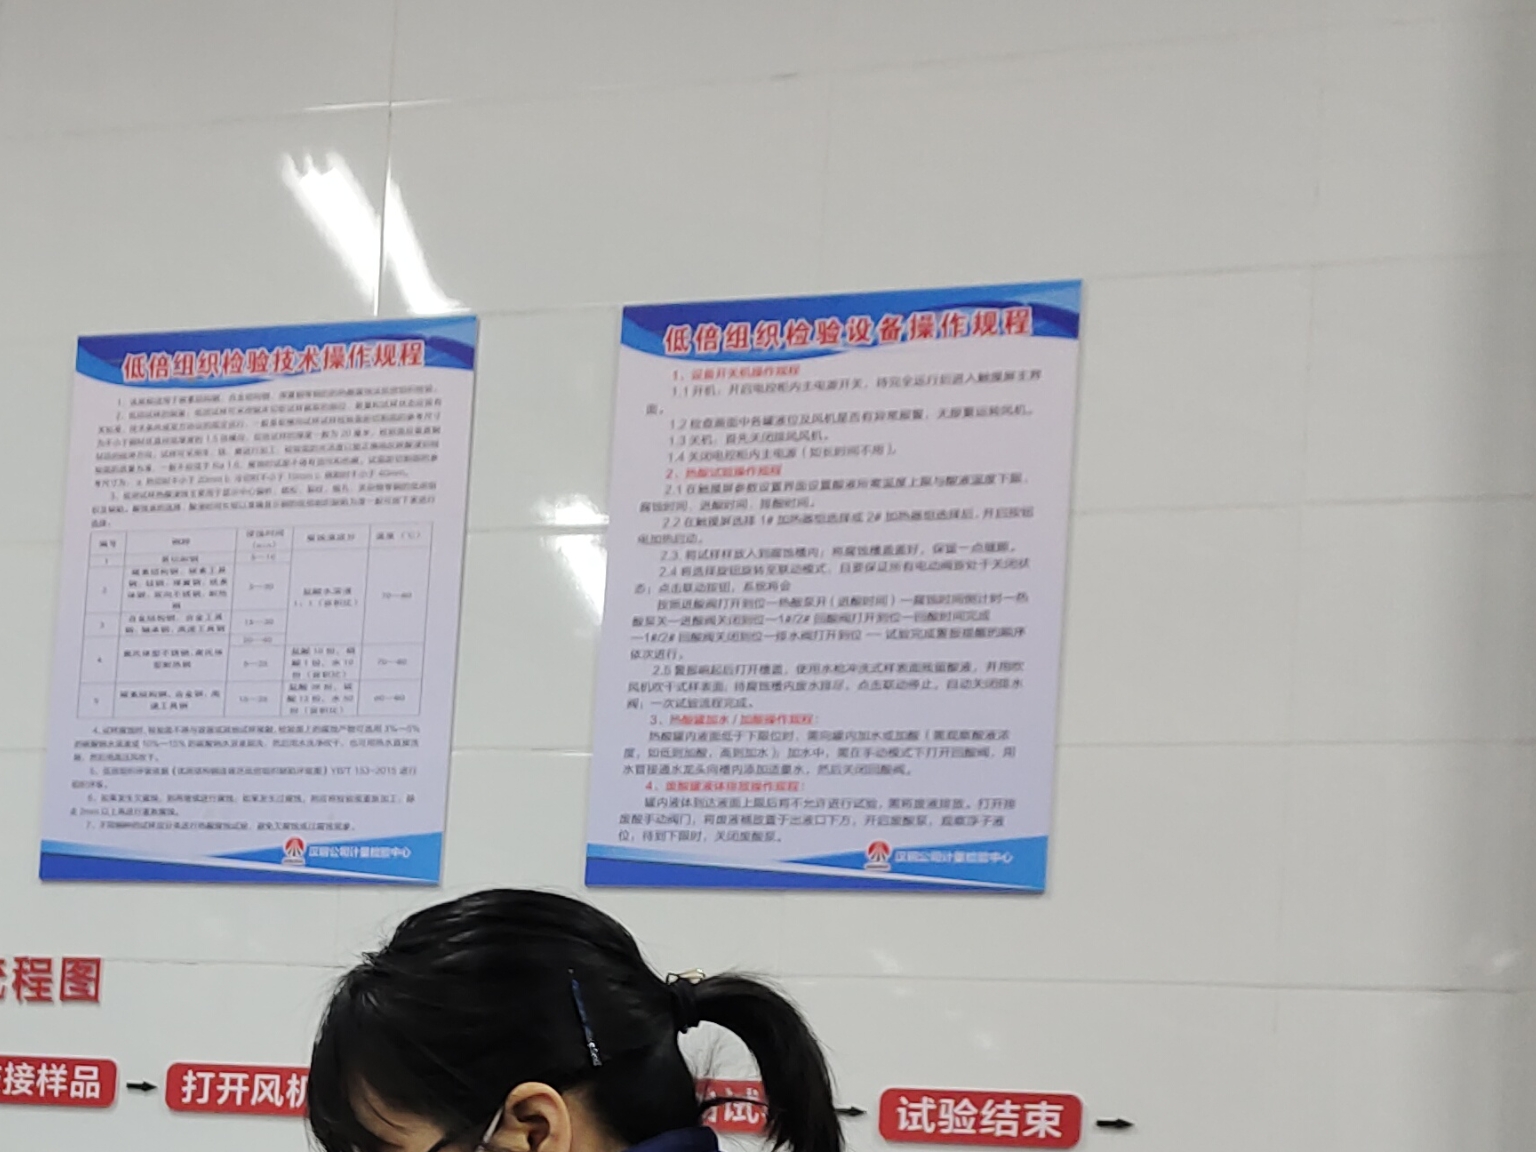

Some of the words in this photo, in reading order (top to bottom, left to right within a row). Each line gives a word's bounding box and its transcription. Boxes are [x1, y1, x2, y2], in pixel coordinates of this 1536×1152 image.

[663, 303, 1033, 354] 低倍组织检验设备操作规程
[121, 338, 426, 381] 低倍组织检验技术操作规程
[181, 1072, 308, 1109] 打开风机
[895, 1097, 1064, 1139] 试验结束
